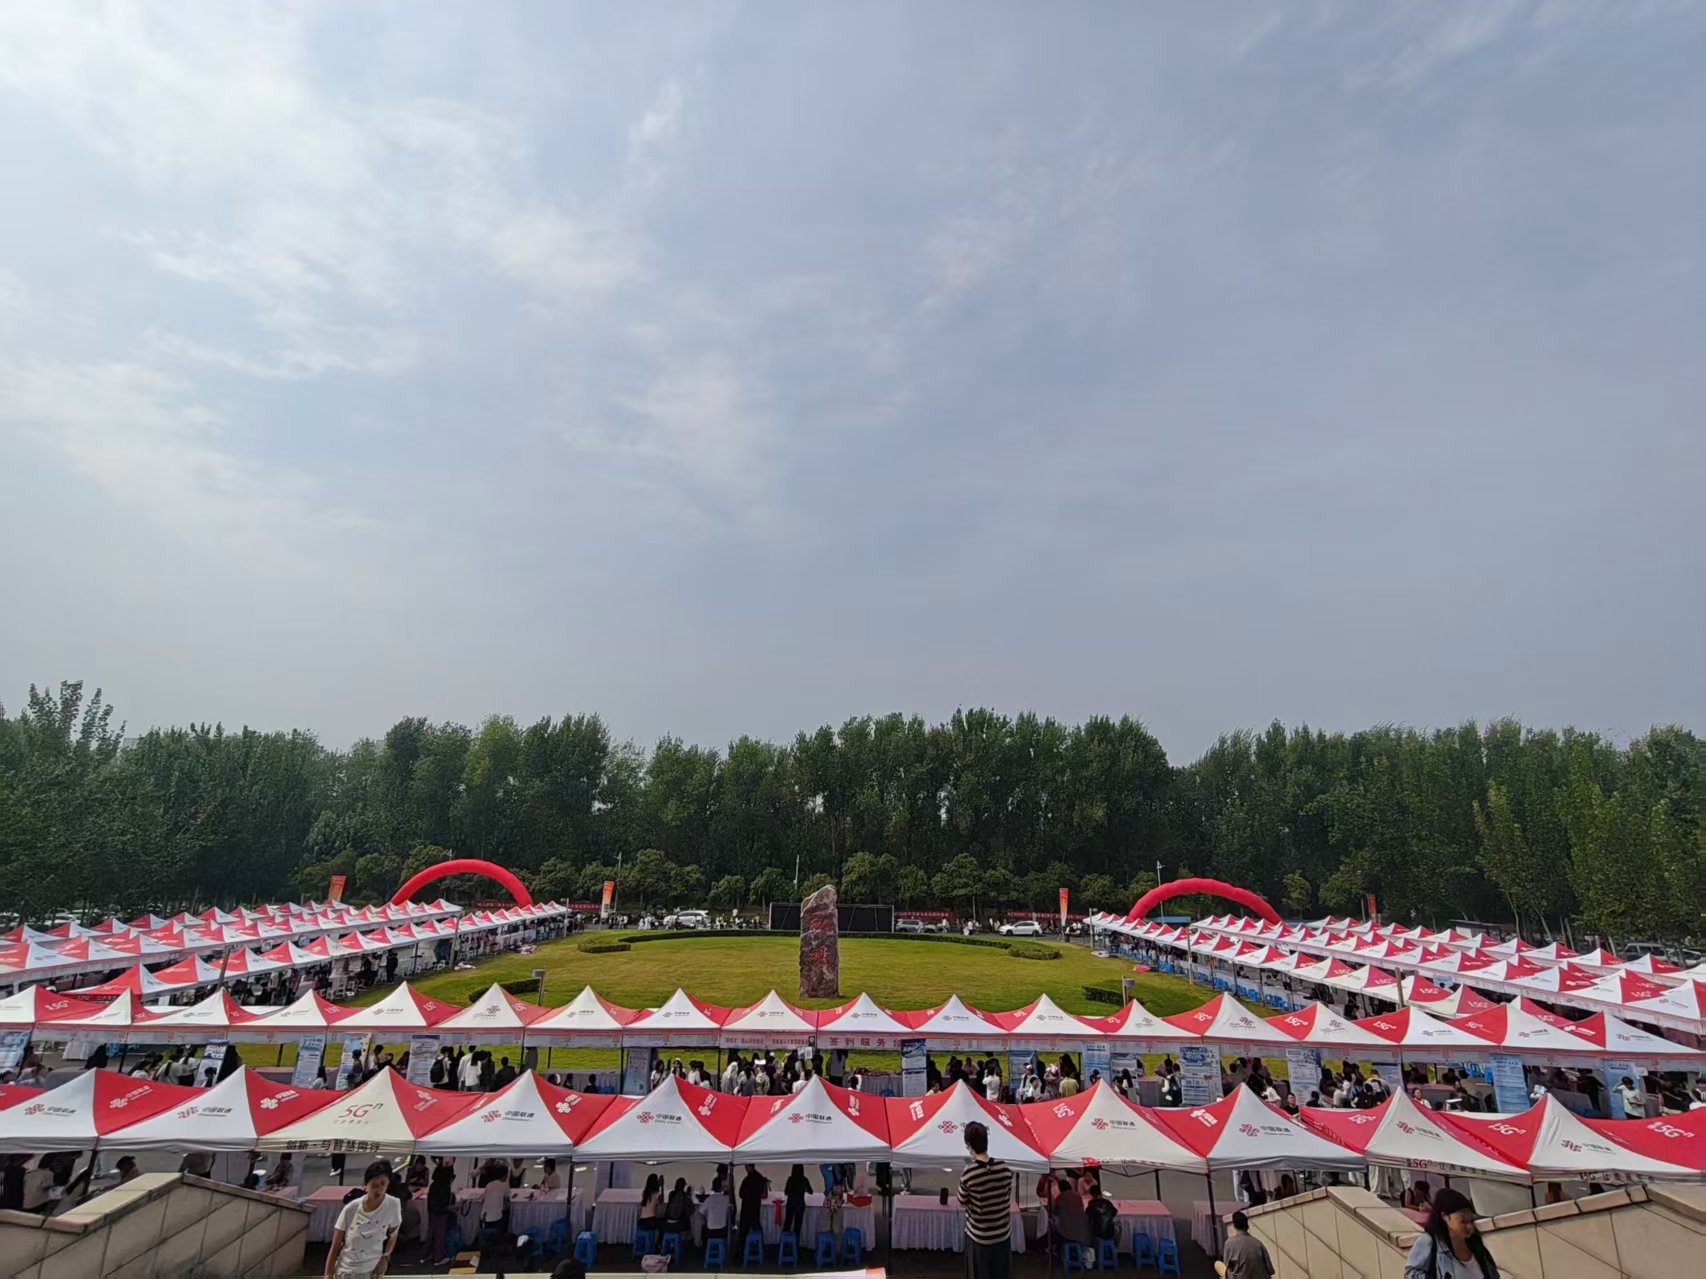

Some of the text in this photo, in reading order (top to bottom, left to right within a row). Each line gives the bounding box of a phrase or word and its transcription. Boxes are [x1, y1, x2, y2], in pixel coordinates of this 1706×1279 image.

[829, 1037, 901, 1048] 签到服务台
[505, 1110, 535, 1118] 中国联通
[655, 1113, 681, 1121] 中国联通
